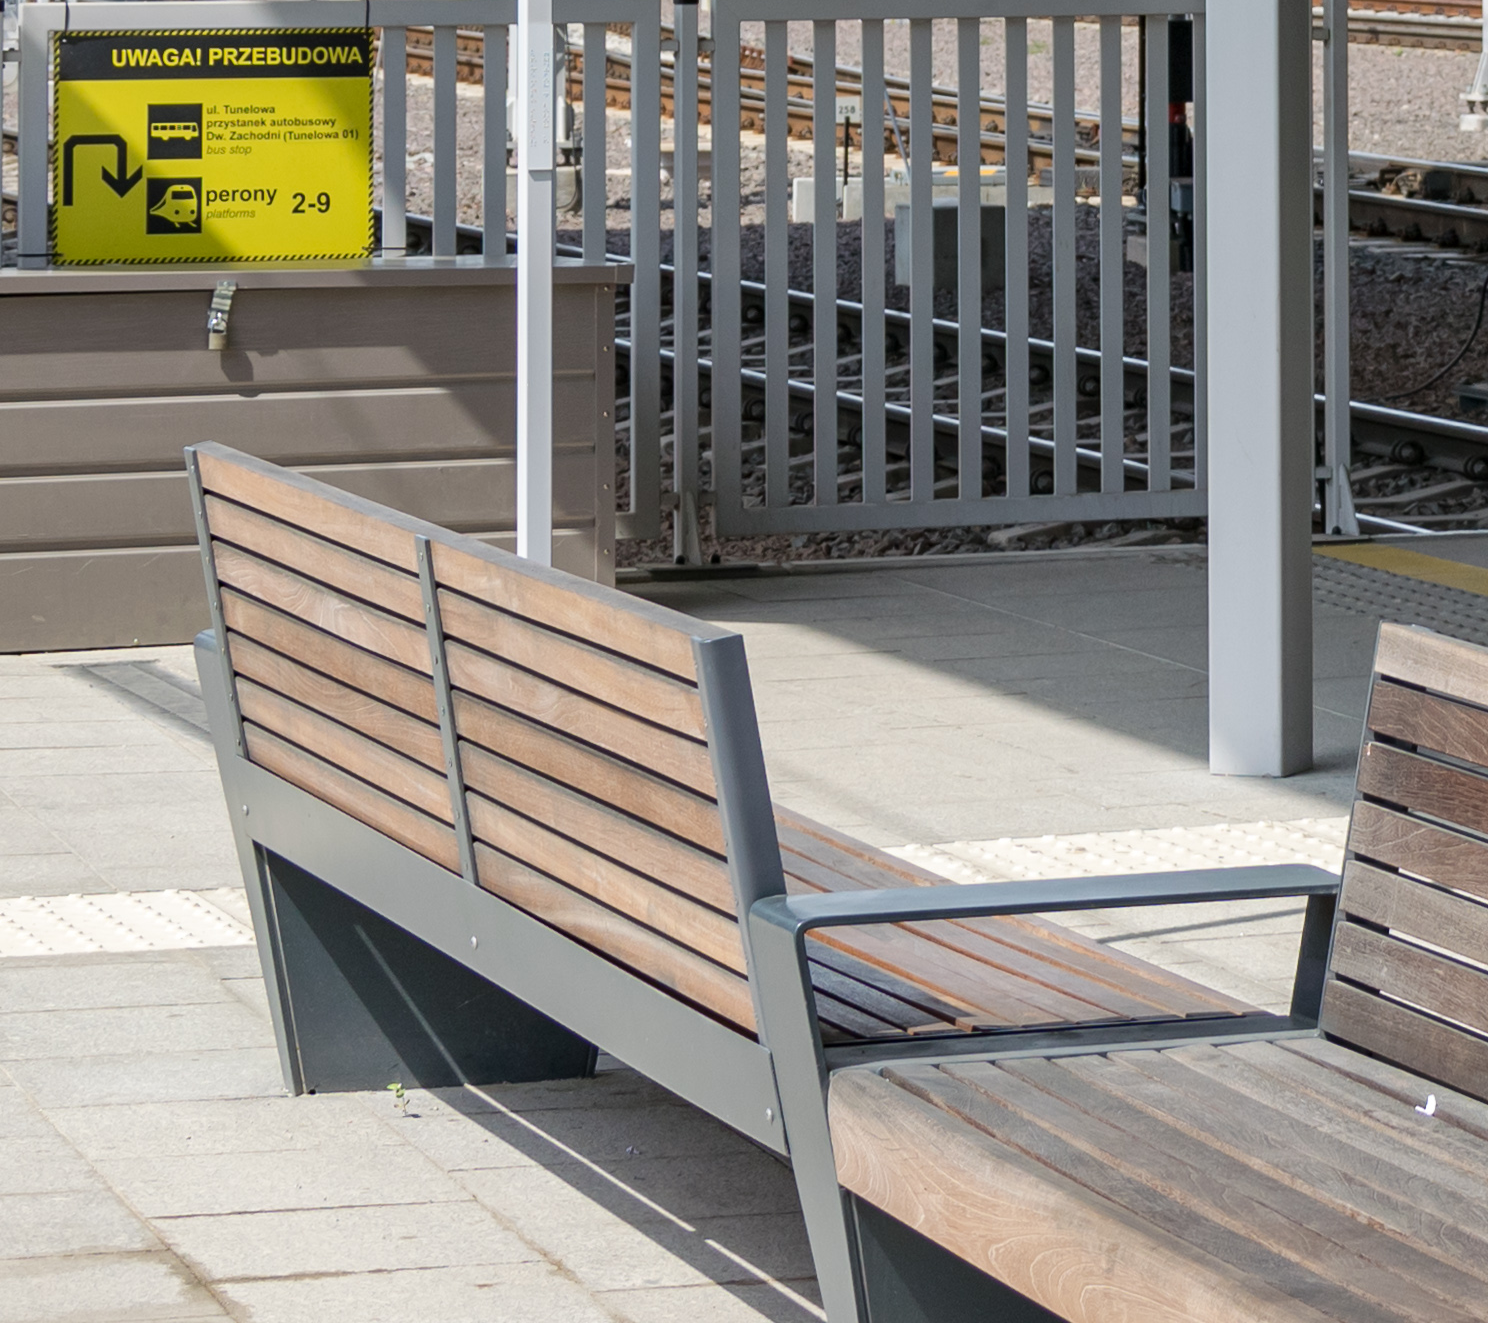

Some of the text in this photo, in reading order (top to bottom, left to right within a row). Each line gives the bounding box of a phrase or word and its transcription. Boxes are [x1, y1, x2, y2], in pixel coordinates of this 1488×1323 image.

[111, 46, 363, 68] UWAGA! PRZEBUDOWA
[206, 104, 275, 115] ul. Tunelowa
[206, 117, 337, 129] przystanek autobusowy
[206, 129, 359, 142] Dw. Zachodni (Tunelowa 01)
[206, 144, 252, 156] bus stop
[205, 188, 331, 214] perony 2-9
[205, 209, 256, 220] platforms
